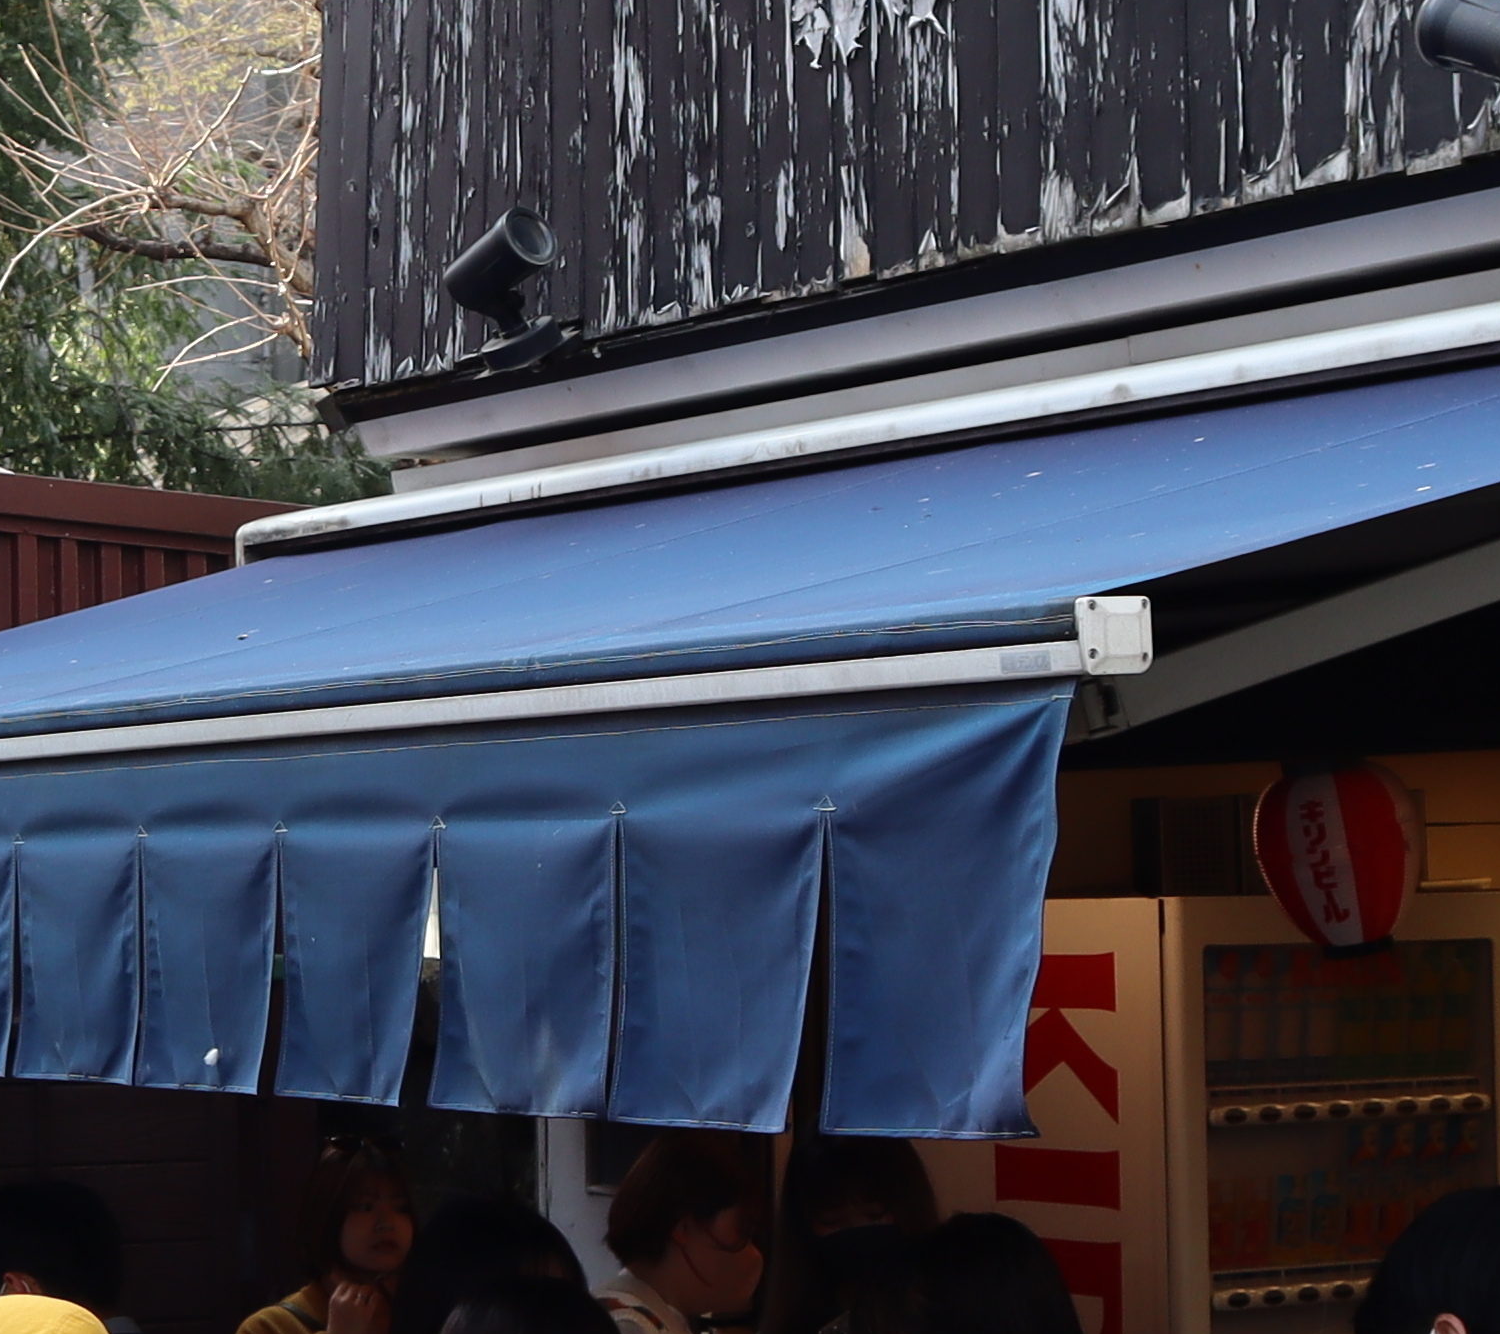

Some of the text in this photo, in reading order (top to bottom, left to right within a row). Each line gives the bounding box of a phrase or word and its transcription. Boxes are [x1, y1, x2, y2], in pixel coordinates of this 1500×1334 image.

[1297, 798, 1352, 927] キリンビール
